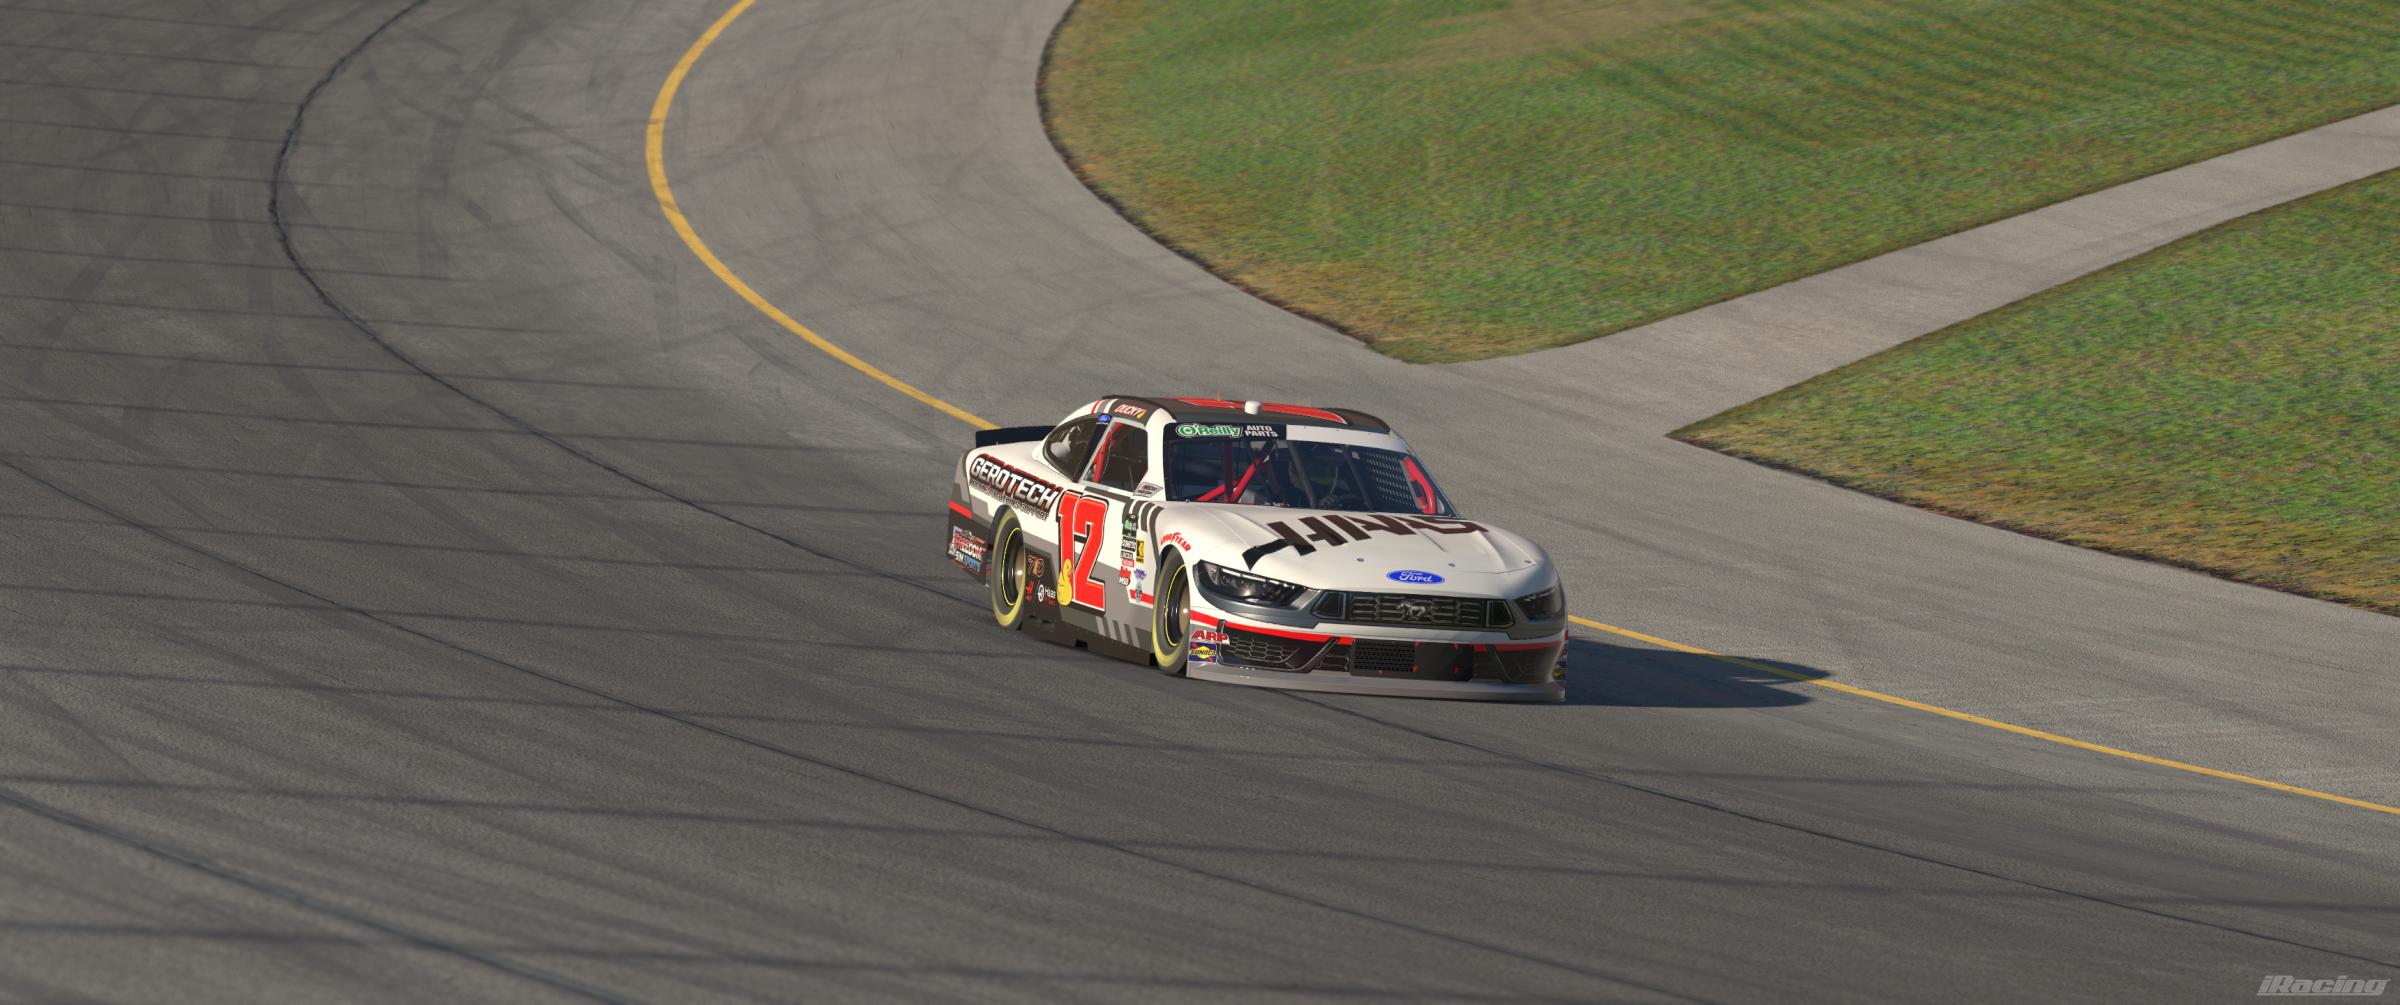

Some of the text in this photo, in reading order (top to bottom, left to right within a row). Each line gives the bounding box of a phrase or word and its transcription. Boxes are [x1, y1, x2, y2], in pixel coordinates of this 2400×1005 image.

[1178, 424, 1242, 438] O'Reilly
[1244, 430, 1278, 438] PARTS
[970, 456, 1061, 513] GEROTECH
[1160, 532, 1191, 551] GOODYEAR
[1243, 514, 1489, 571] HAAS
[1056, 489, 1109, 616] 12
[1400, 571, 1433, 582] Ford
[1190, 629, 1229, 643] ARP
